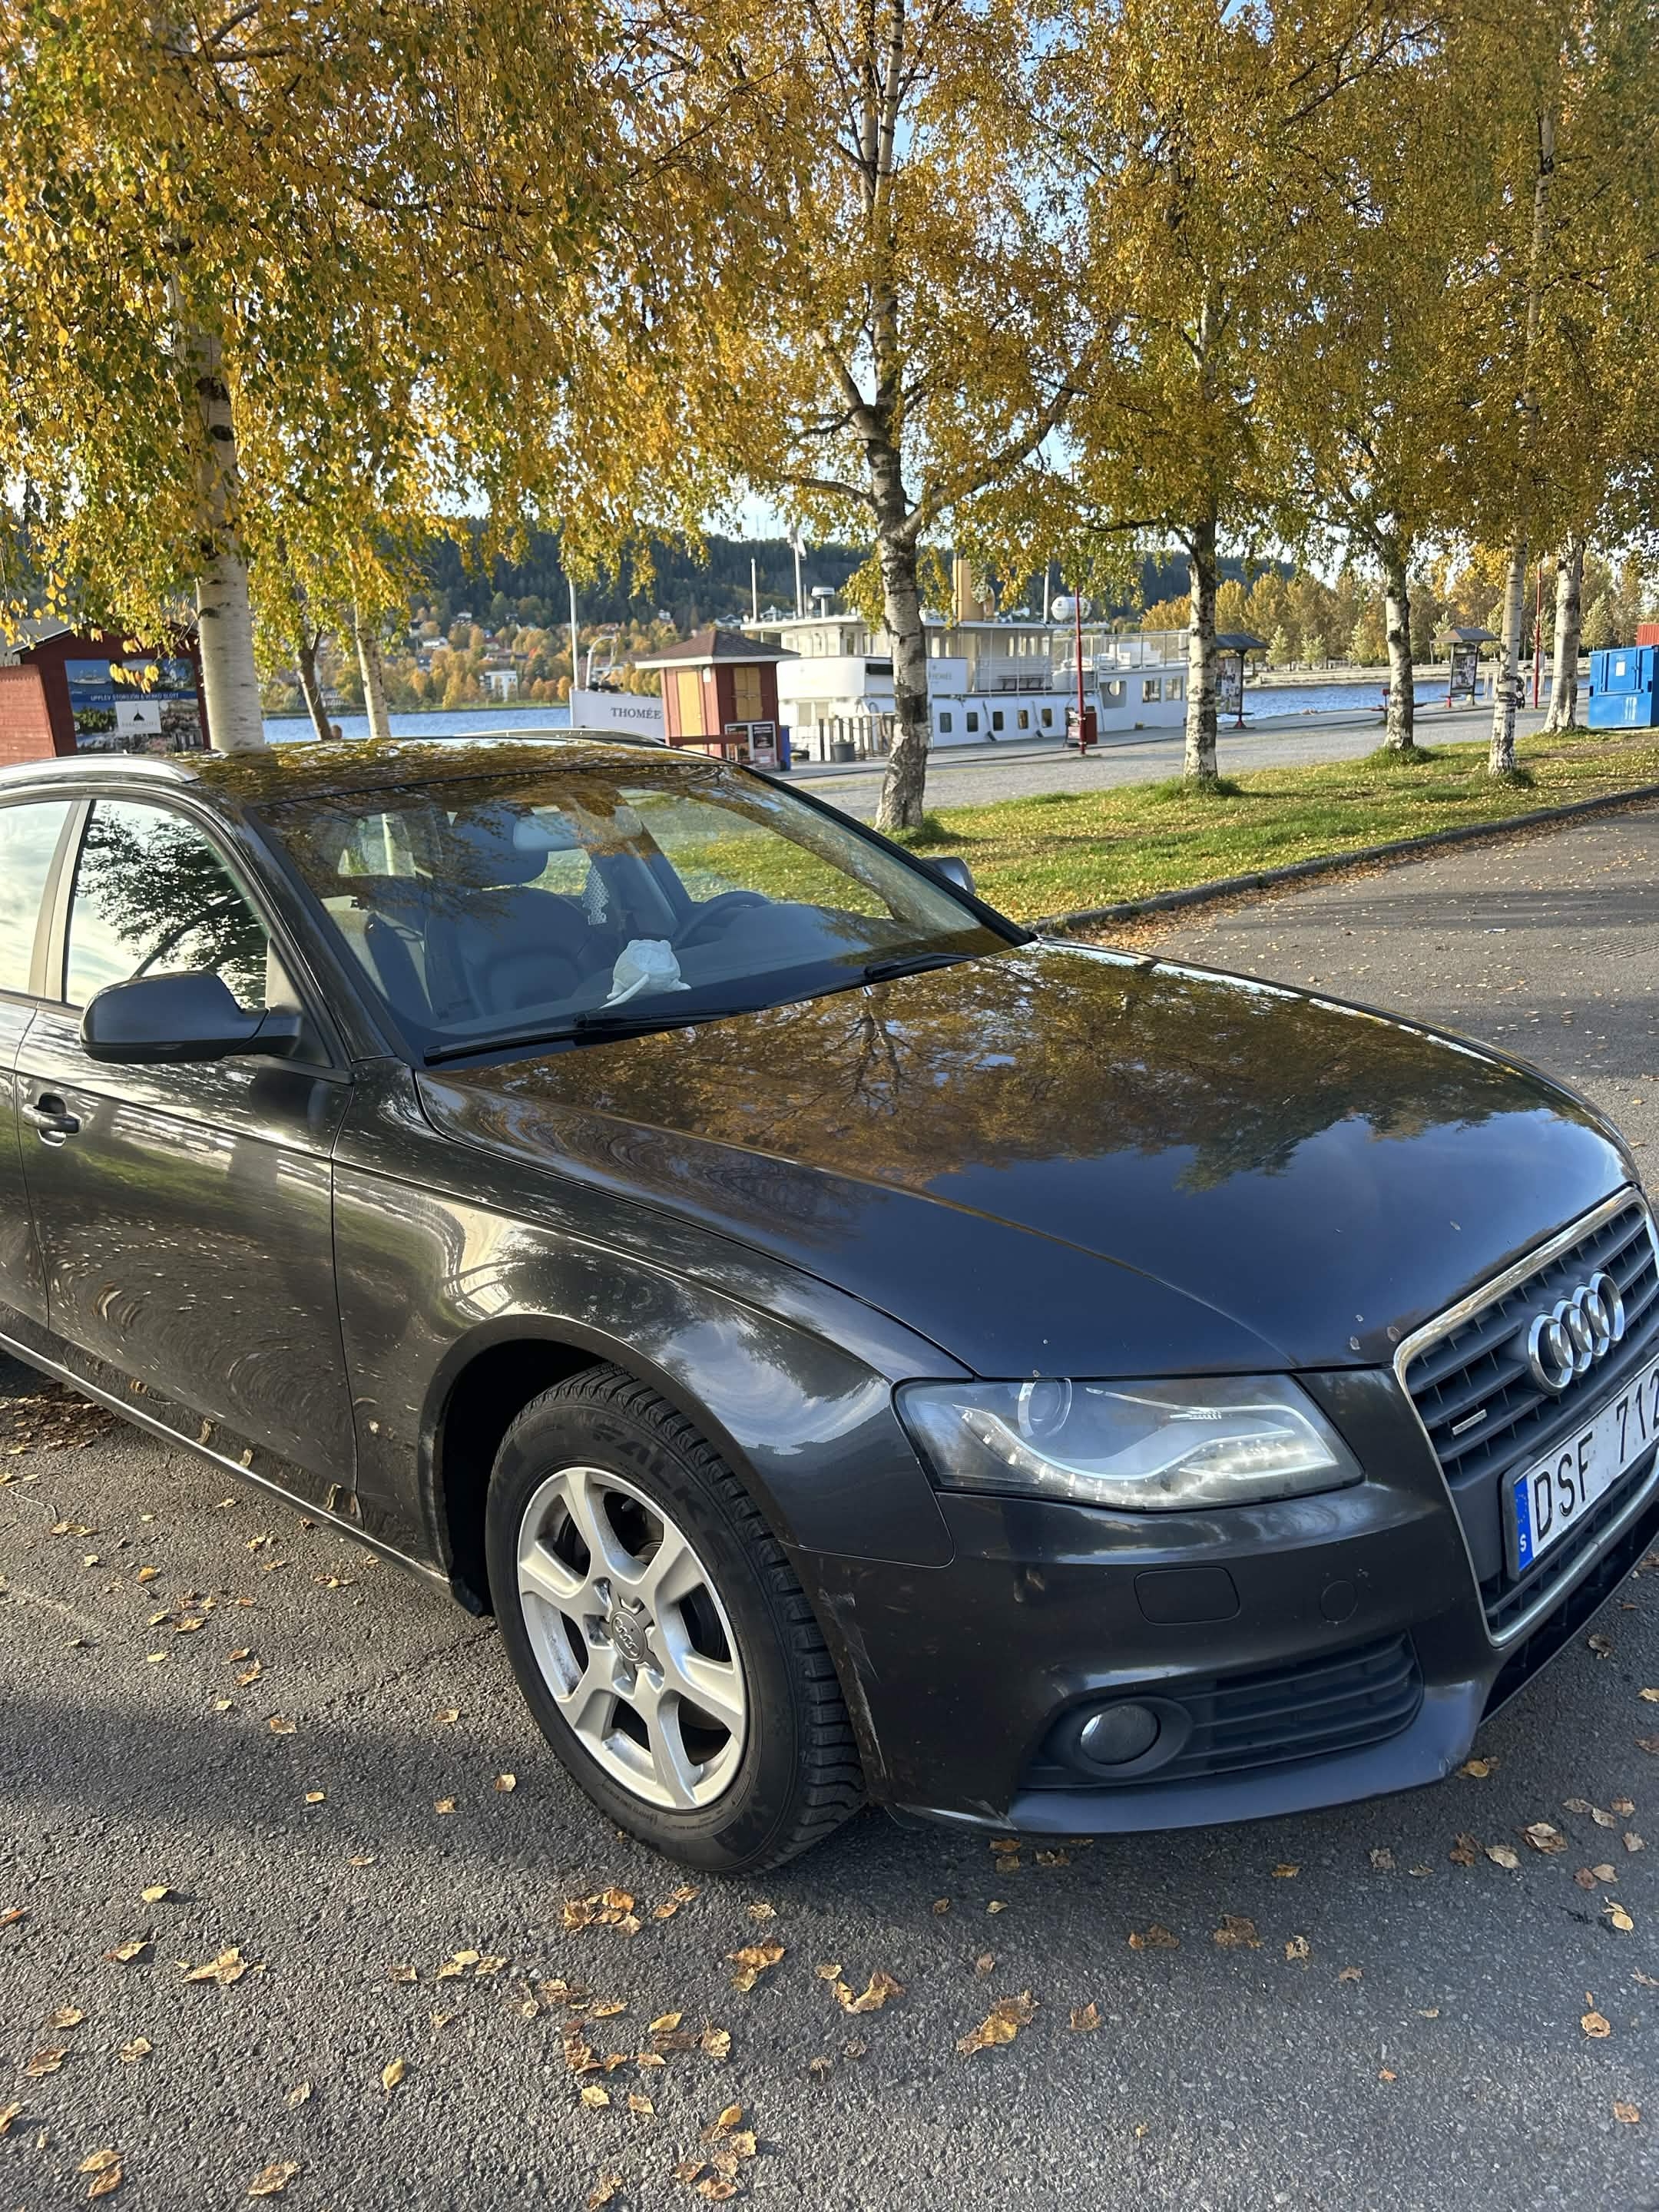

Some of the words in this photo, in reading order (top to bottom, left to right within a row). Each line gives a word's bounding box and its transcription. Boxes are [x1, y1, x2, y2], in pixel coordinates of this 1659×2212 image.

[611, 707, 661, 719] THOMÉE
[1534, 1429, 1593, 1542] DSF
[1616, 1368, 1659, 1464] 712
[1519, 1534, 1527, 1552] S
